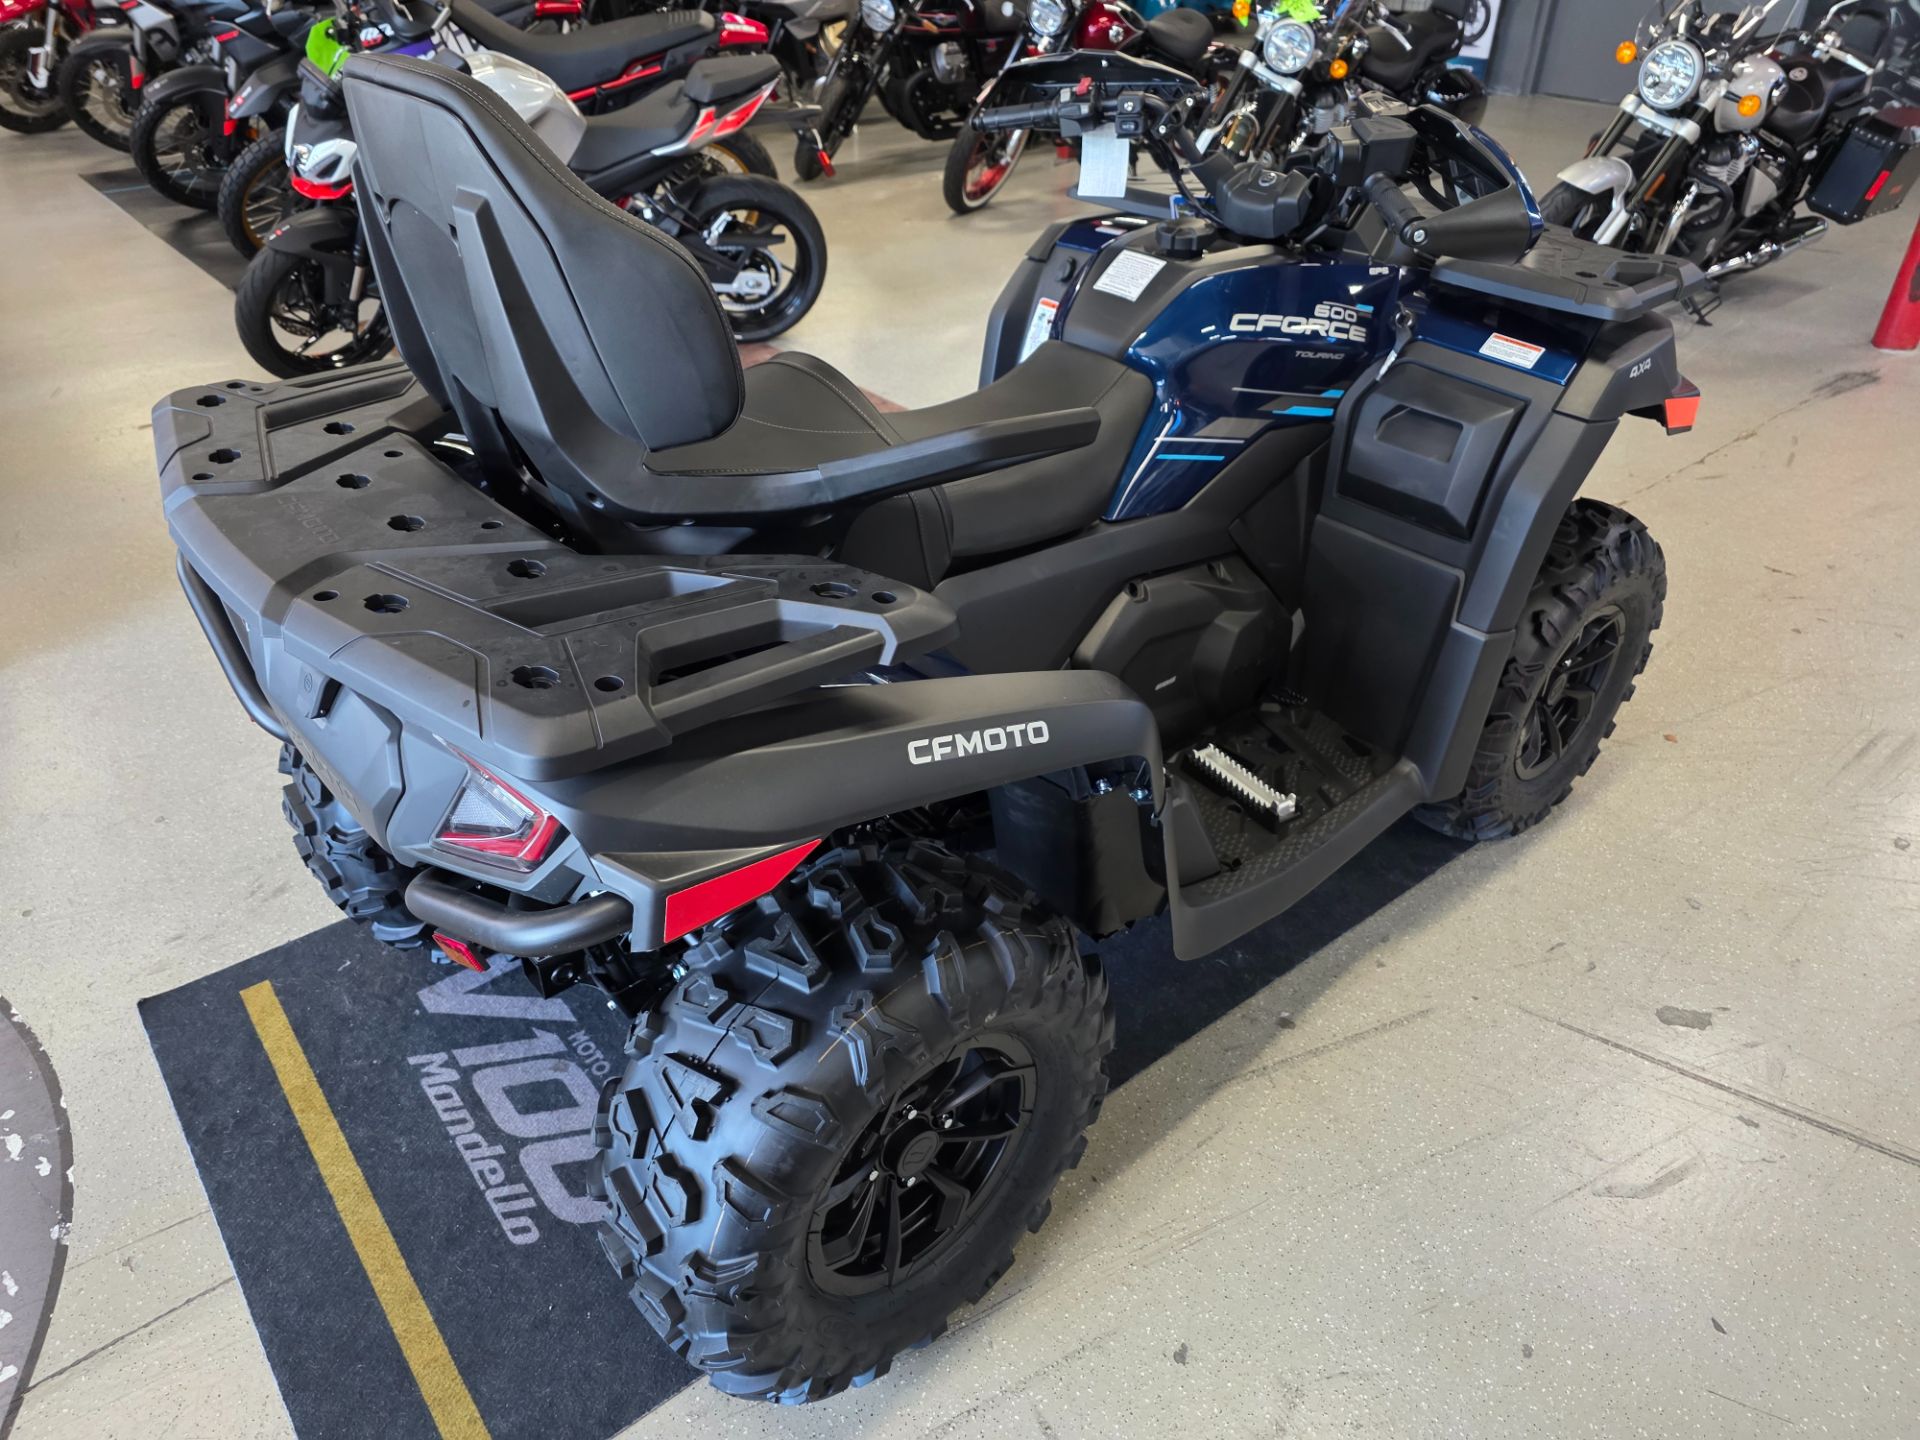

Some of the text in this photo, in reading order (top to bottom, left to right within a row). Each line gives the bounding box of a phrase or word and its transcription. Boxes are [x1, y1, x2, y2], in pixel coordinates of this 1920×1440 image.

[1229, 313, 1367, 342] CFORCE
[1314, 303, 1358, 323] 600
[1295, 350, 1345, 360] TOURING
[907, 720, 1050, 765] CFMOTO
[567, 1029, 611, 1076] MOTO
[406, 1051, 541, 1246] Mandello
